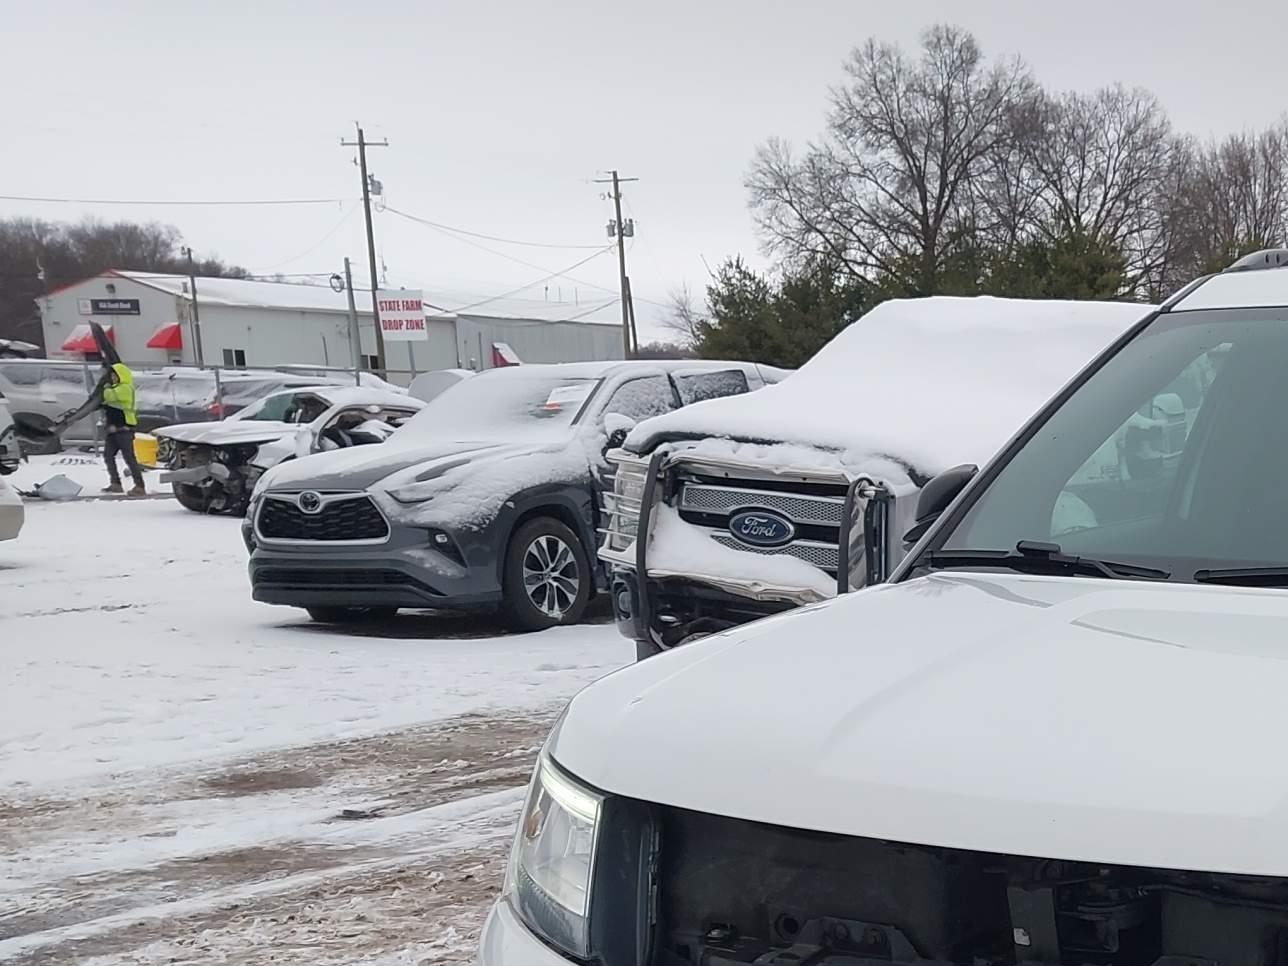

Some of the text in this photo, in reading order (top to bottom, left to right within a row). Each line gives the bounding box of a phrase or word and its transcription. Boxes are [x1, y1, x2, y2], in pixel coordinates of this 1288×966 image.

[379, 300, 422, 311] STATE FARM
[382, 319, 425, 330] DROP ZONE
[741, 516, 777, 537] Ford
